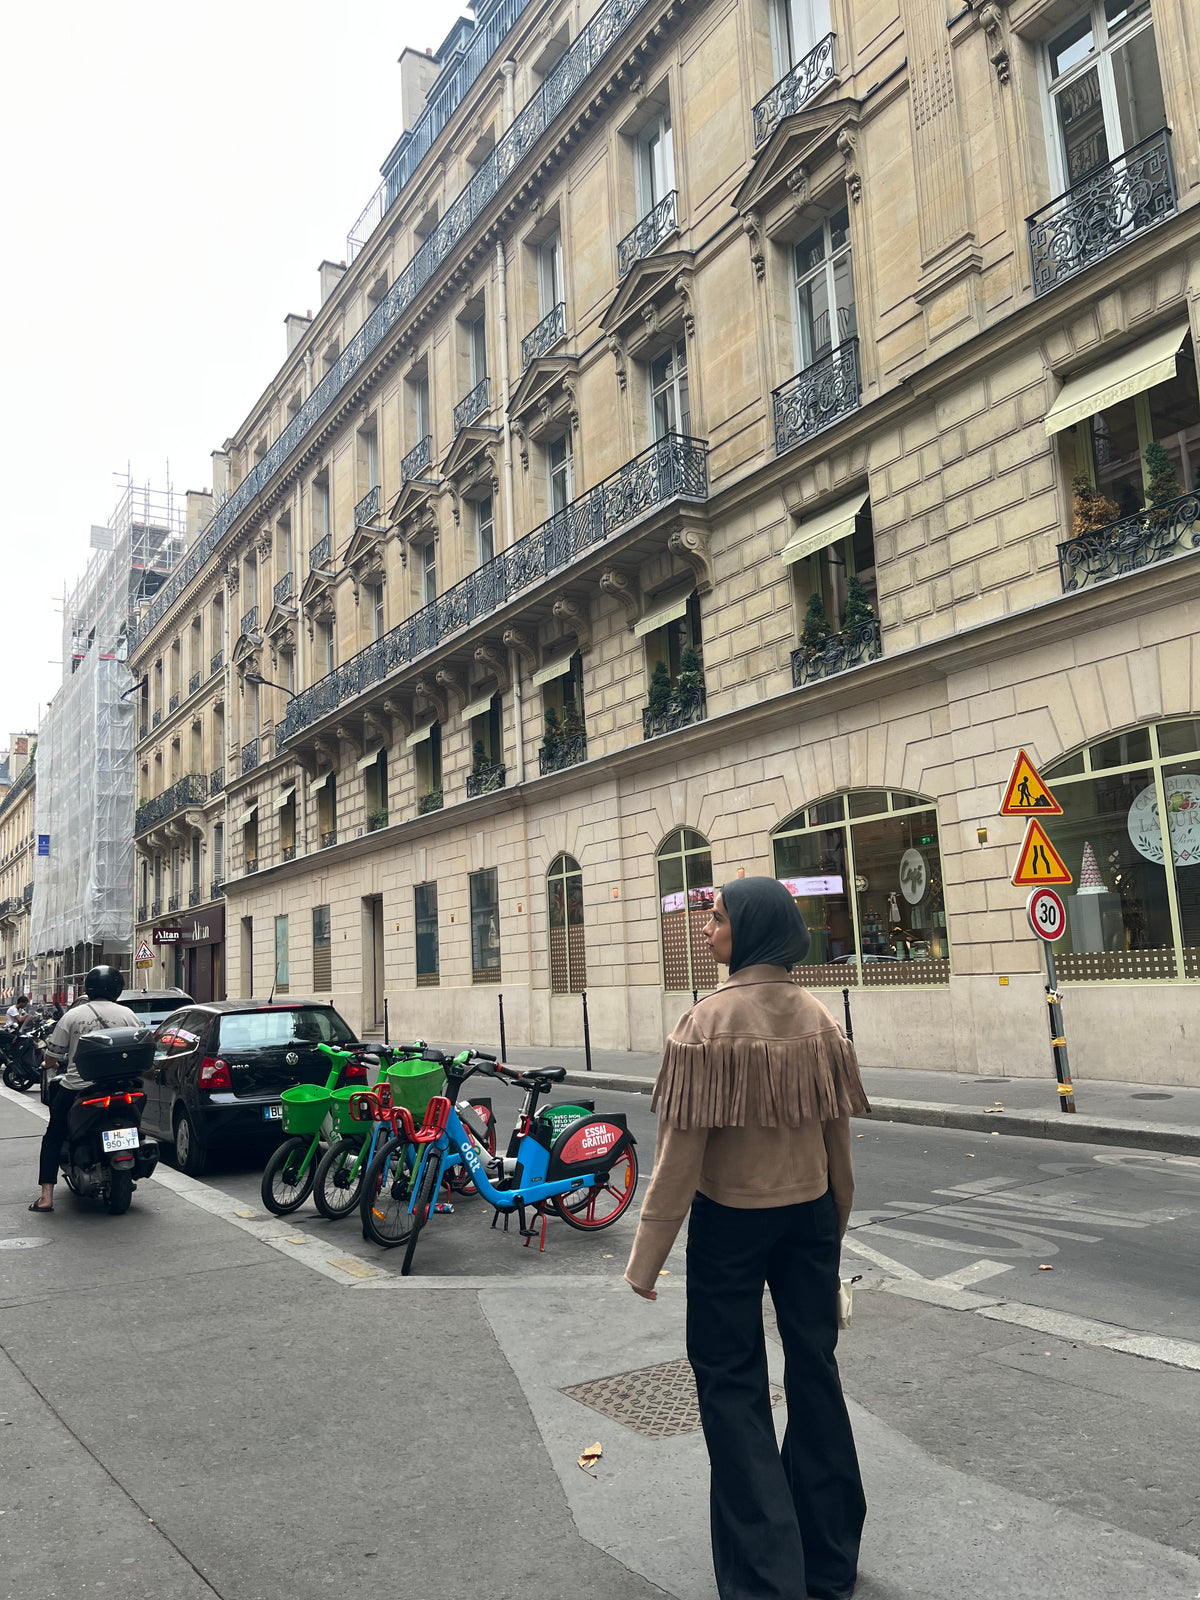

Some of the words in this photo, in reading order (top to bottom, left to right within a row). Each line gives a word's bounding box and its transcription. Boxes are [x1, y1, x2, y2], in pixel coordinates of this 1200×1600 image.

[1040, 903, 1056, 926] 30
[155, 930, 180, 939] Altan
[585, 1125, 606, 1138] ESSAI
[461, 1142, 480, 1173] dott
